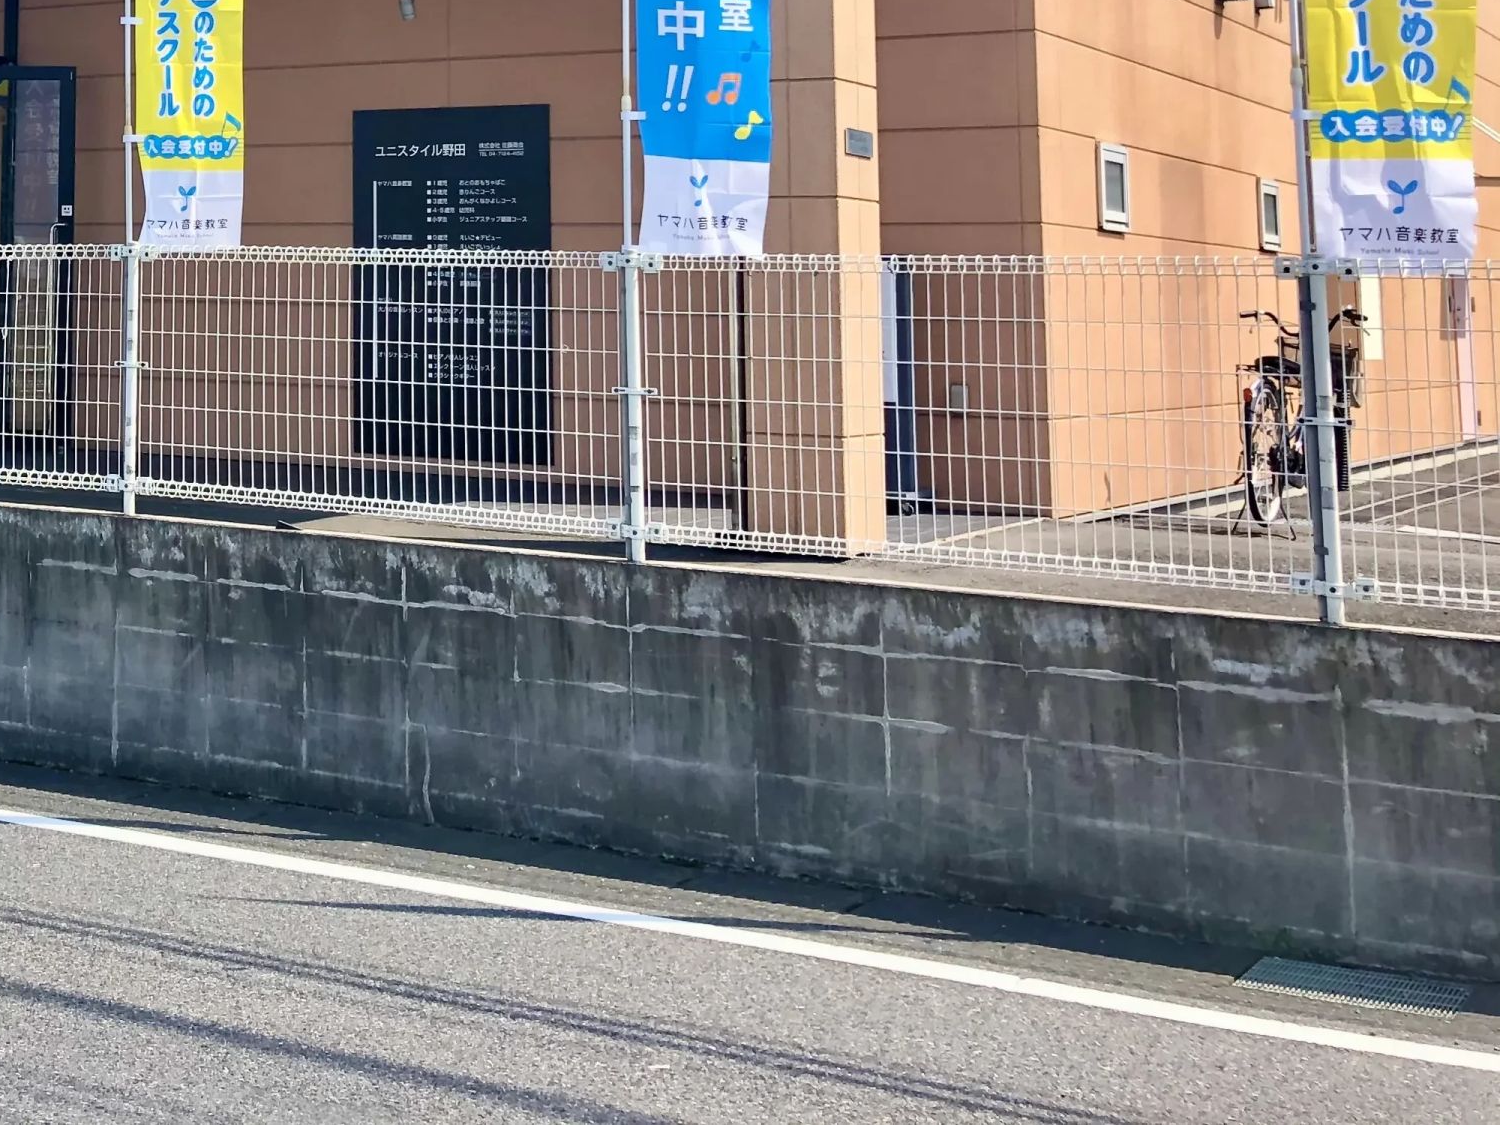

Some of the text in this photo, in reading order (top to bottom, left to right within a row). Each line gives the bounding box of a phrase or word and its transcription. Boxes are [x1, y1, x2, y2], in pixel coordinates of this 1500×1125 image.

[1328, 114, 1464, 140] 入会受付中!
[375, 143, 466, 157] ユニスタイル野田
[146, 218, 228, 230] ヤマハ音楽教室
[1339, 225, 1460, 245] ヤマハ音楽教室
